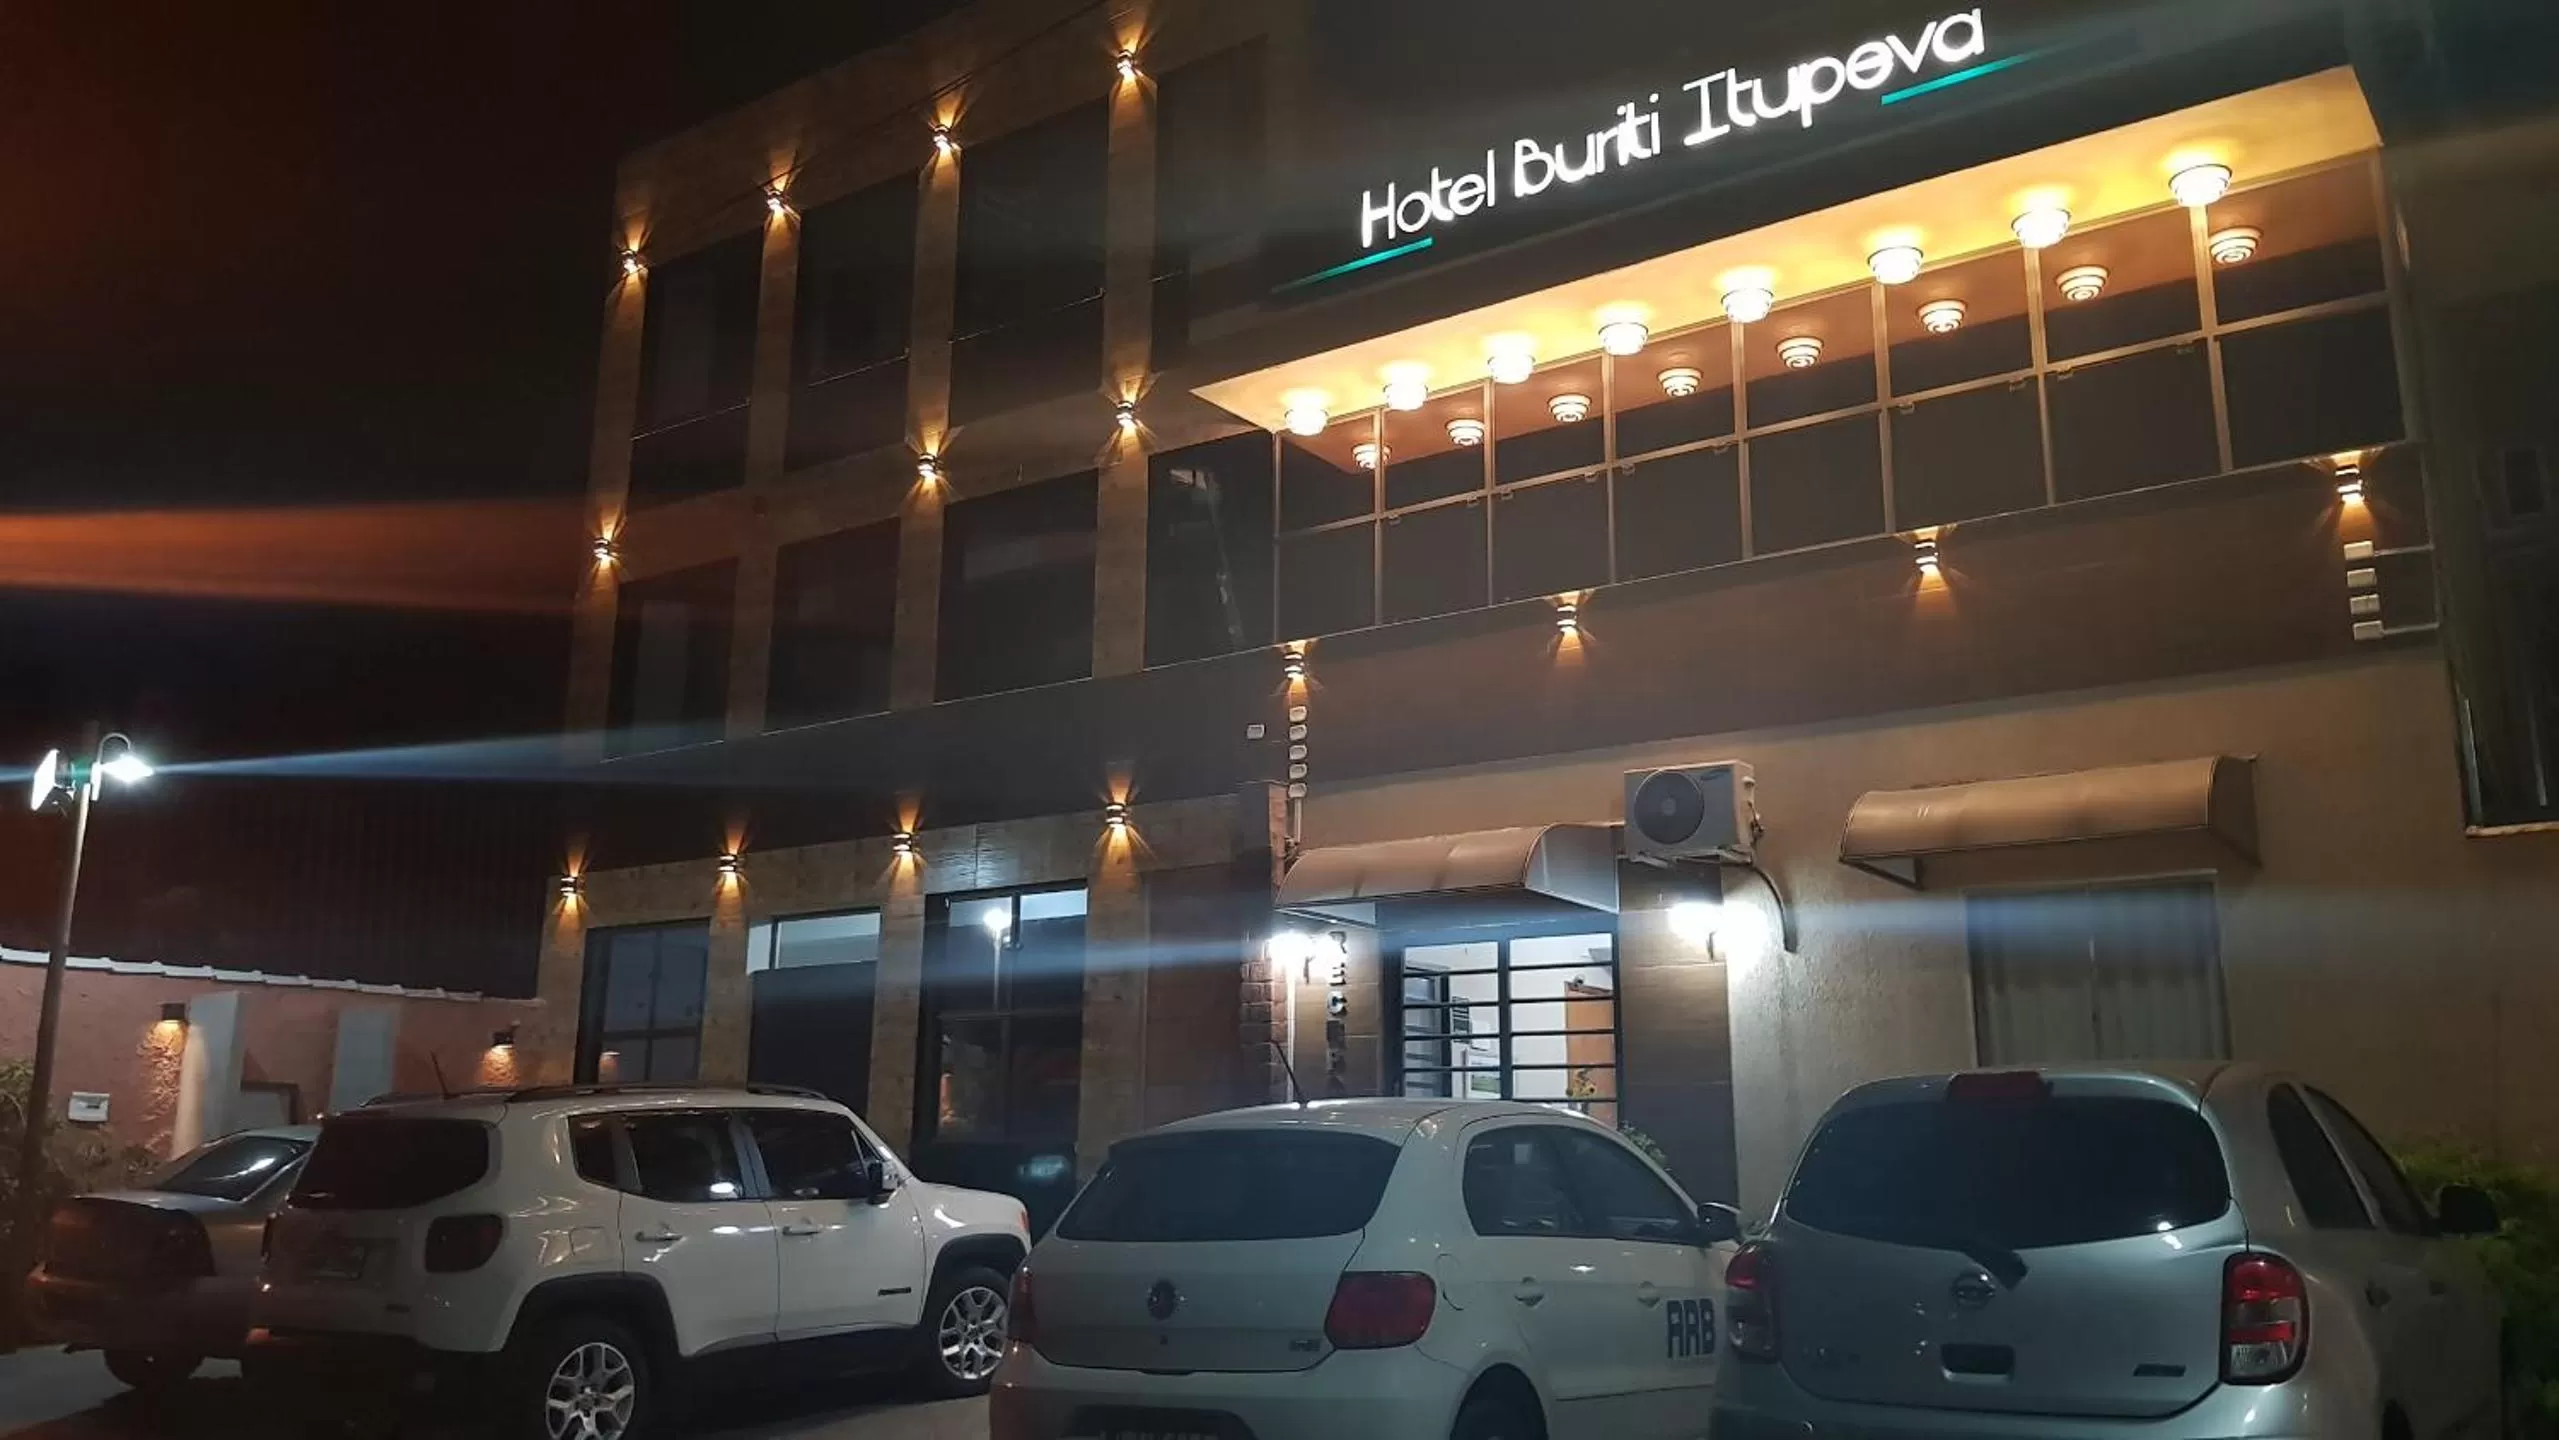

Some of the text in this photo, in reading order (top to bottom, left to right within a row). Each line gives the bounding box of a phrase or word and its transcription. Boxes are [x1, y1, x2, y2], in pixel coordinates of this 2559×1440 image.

[1359, 7, 1986, 248] Hotel Buriti Itupeva
